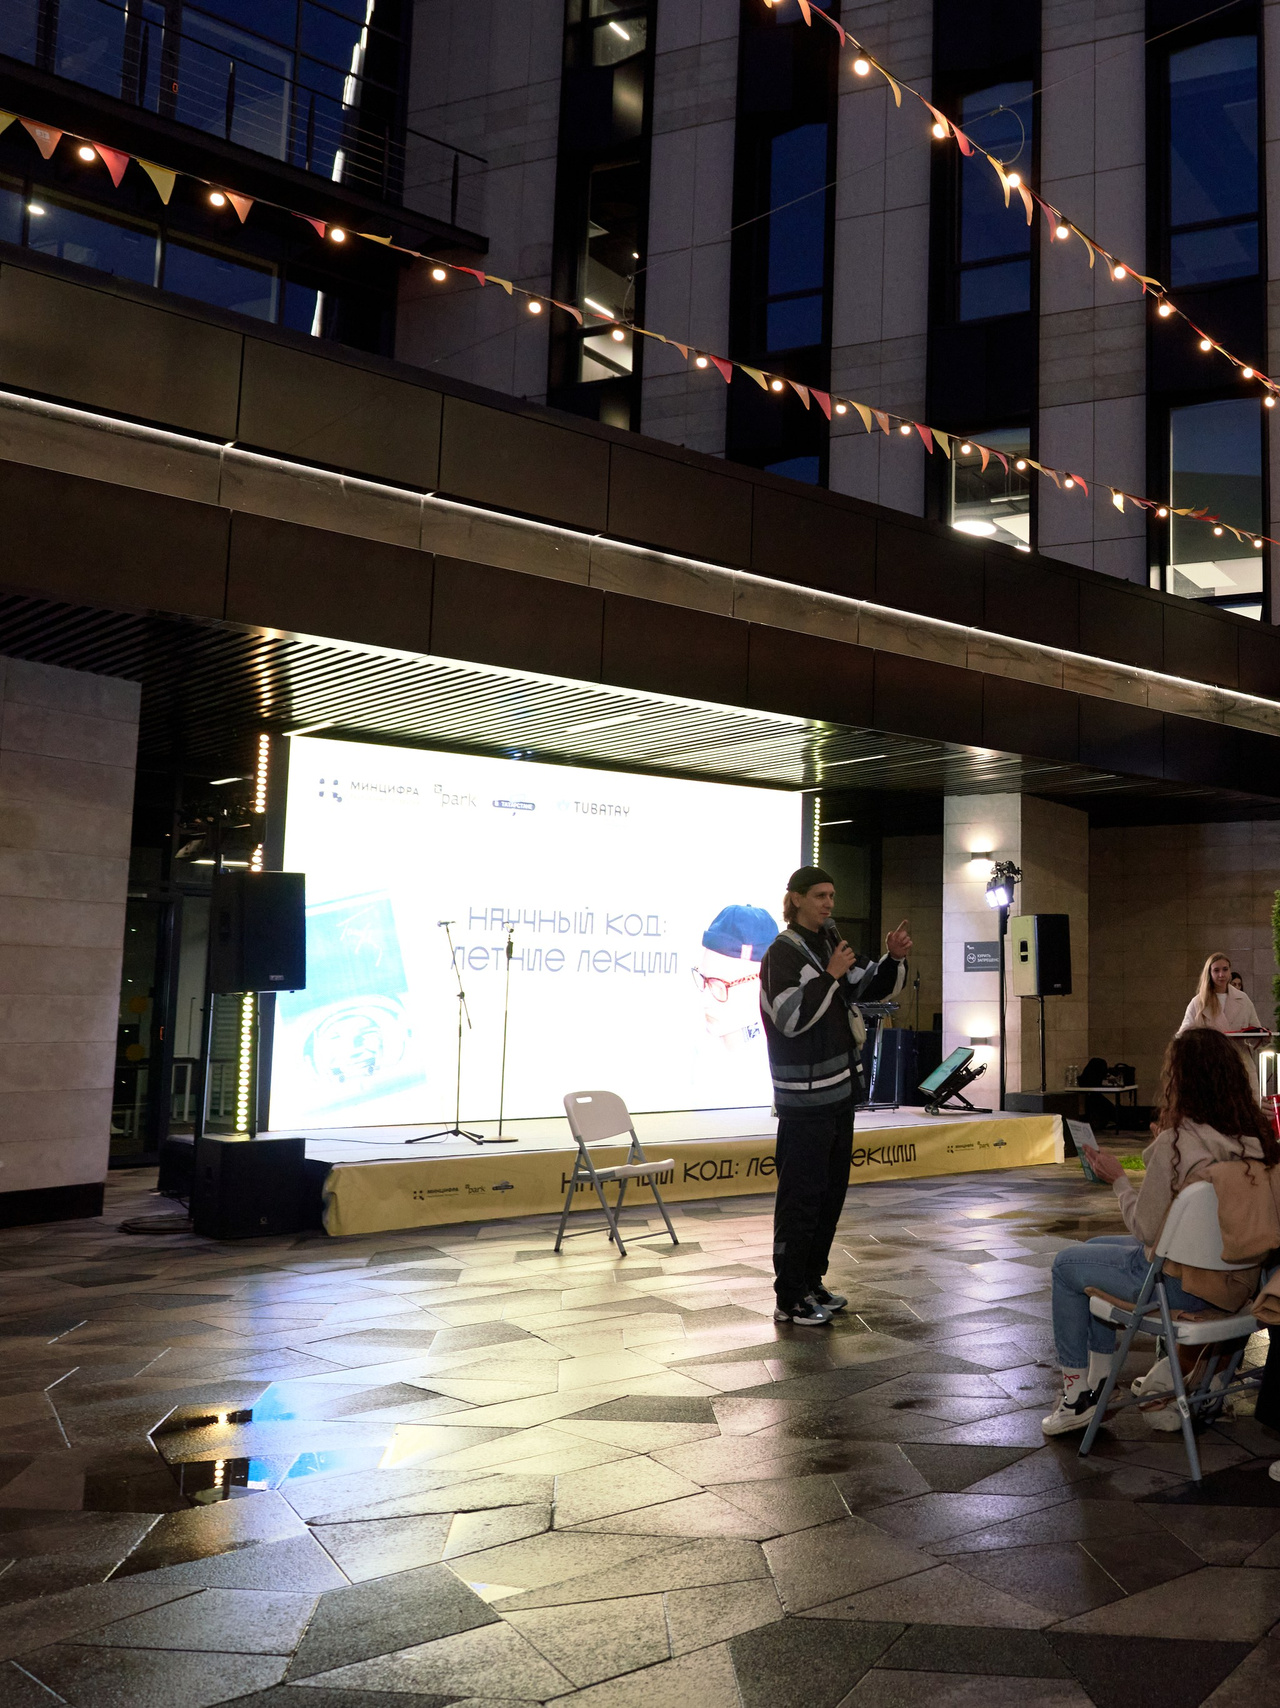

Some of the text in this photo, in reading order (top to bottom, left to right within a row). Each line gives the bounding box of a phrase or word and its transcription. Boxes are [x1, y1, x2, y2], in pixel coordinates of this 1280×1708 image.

[350, 781, 420, 796] МИНЦИФРА
[441, 793, 477, 808] park
[574, 801, 630, 817] TUBATAY
